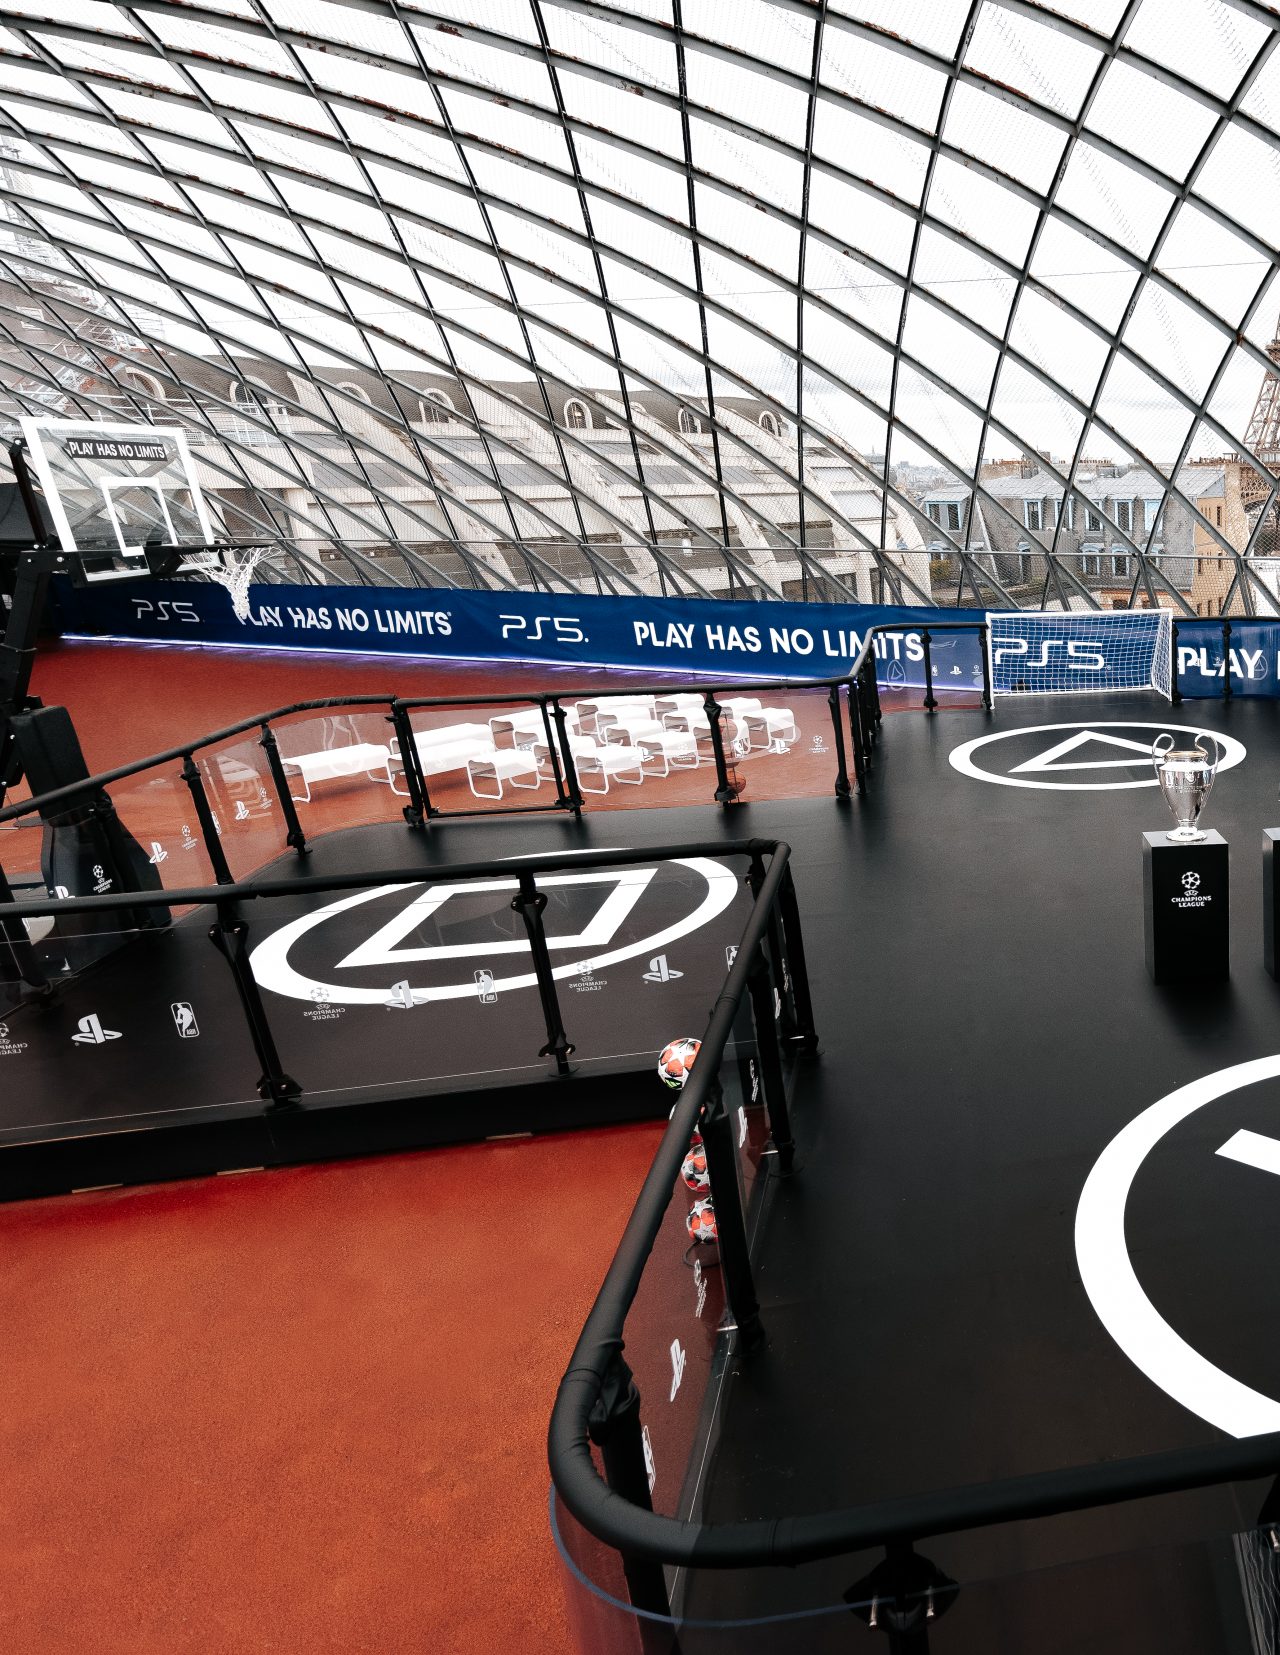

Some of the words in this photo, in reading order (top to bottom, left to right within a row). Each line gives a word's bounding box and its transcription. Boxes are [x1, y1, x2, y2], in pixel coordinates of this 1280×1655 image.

[69, 441, 93, 455] PLAY
[96, 443, 117, 457] HAS
[118, 445, 134, 458] NO
[134, 446, 165, 459] LIMITS
[287, 606, 332, 630] HAS
[335, 608, 369, 632] NO
[375, 609, 452, 636] LIMITS
[633, 621, 695, 649] PLAY
[705, 624, 762, 653] HAS
[769, 628, 814, 656] NO
[823, 630, 925, 662] LIMITS
[993, 638, 1105, 670] PS5
[1177, 646, 1263, 678] PLAY
[1171, 895, 1212, 903] CHAMPIONS
